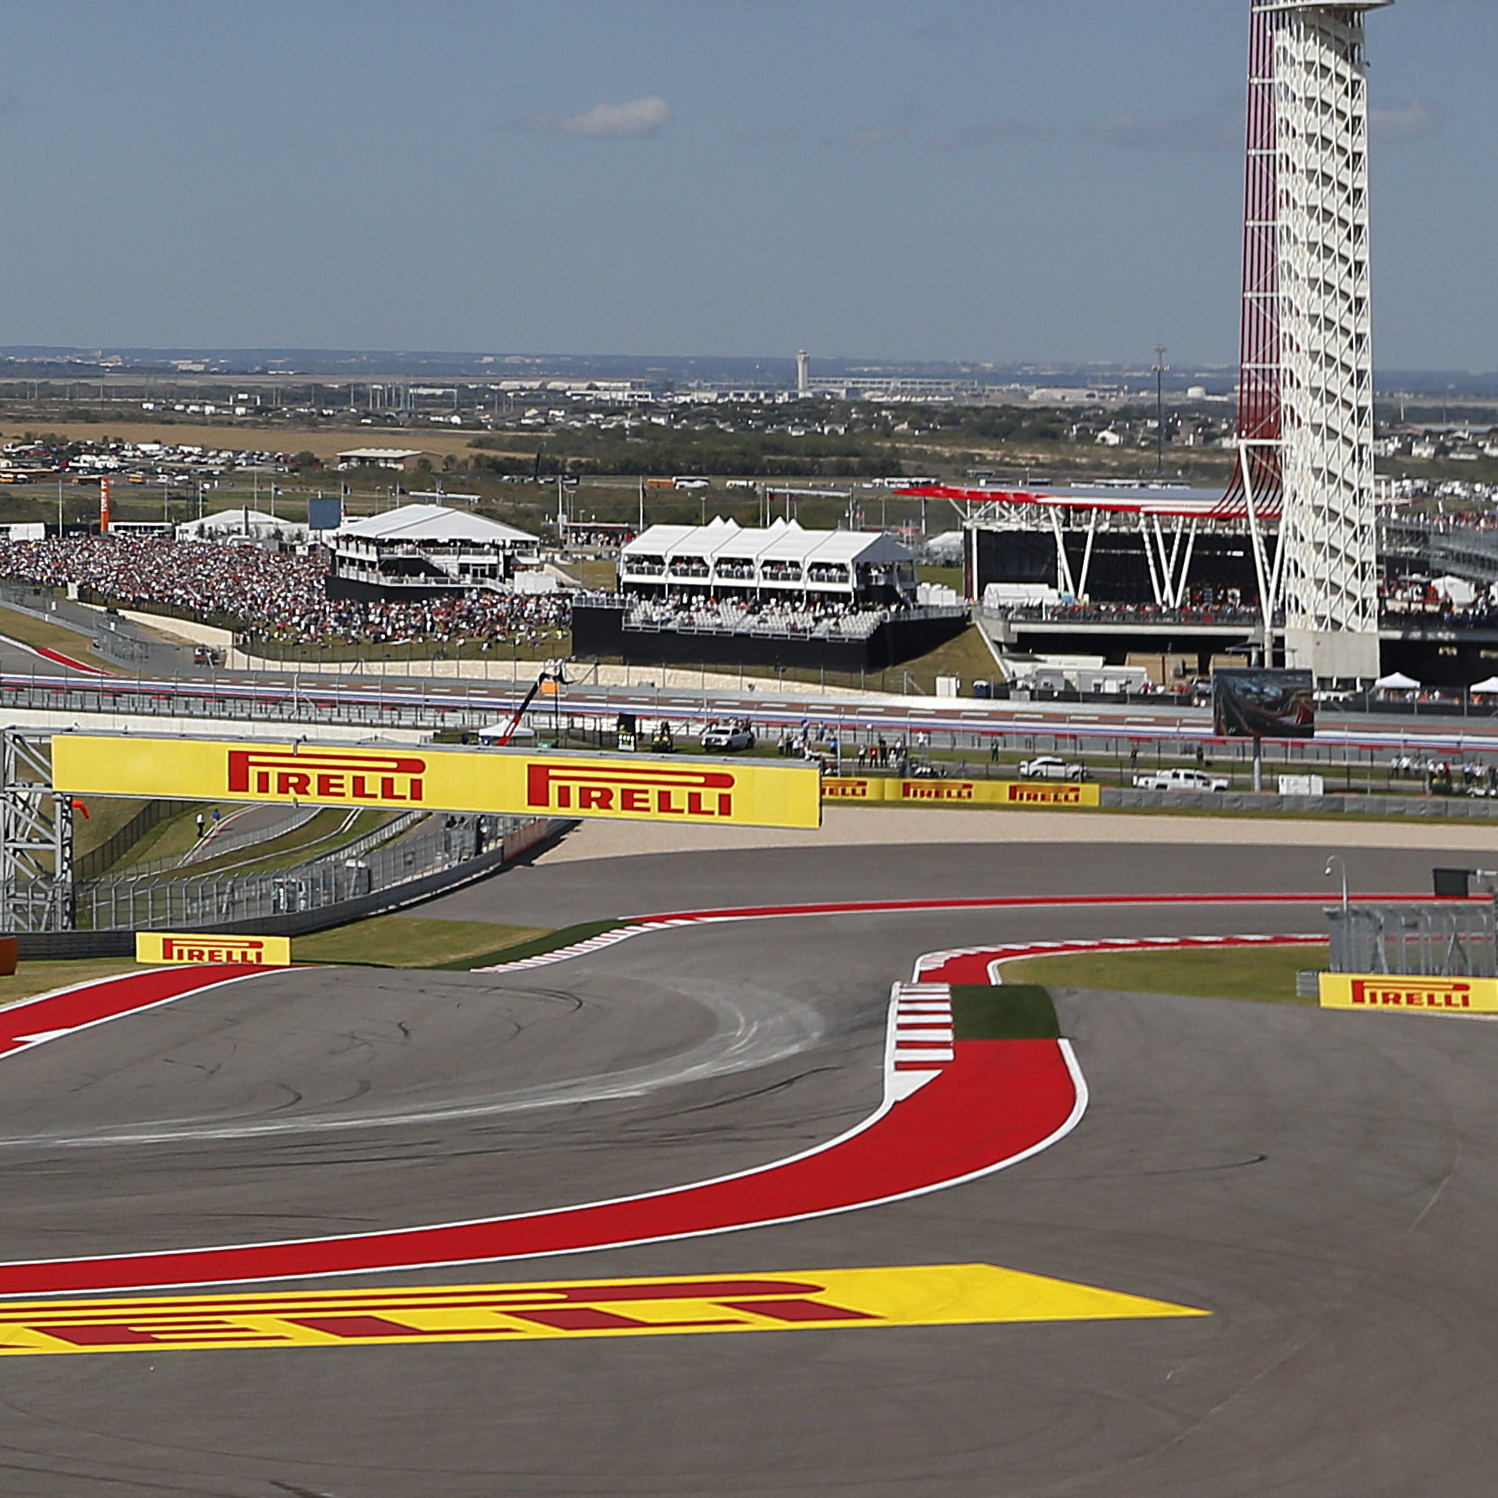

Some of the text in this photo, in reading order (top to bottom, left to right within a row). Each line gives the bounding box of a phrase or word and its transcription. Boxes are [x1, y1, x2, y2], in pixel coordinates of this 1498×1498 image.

[228, 750, 428, 801] PIRELLI
[822, 780, 868, 797] ELLI
[527, 763, 736, 817] PIRELLI
[902, 782, 973, 799] PIRELLI
[1009, 785, 1081, 802] PIRELLI
[162, 937, 264, 965] PIRELLI
[1351, 980, 1470, 1008] PIRELLI
